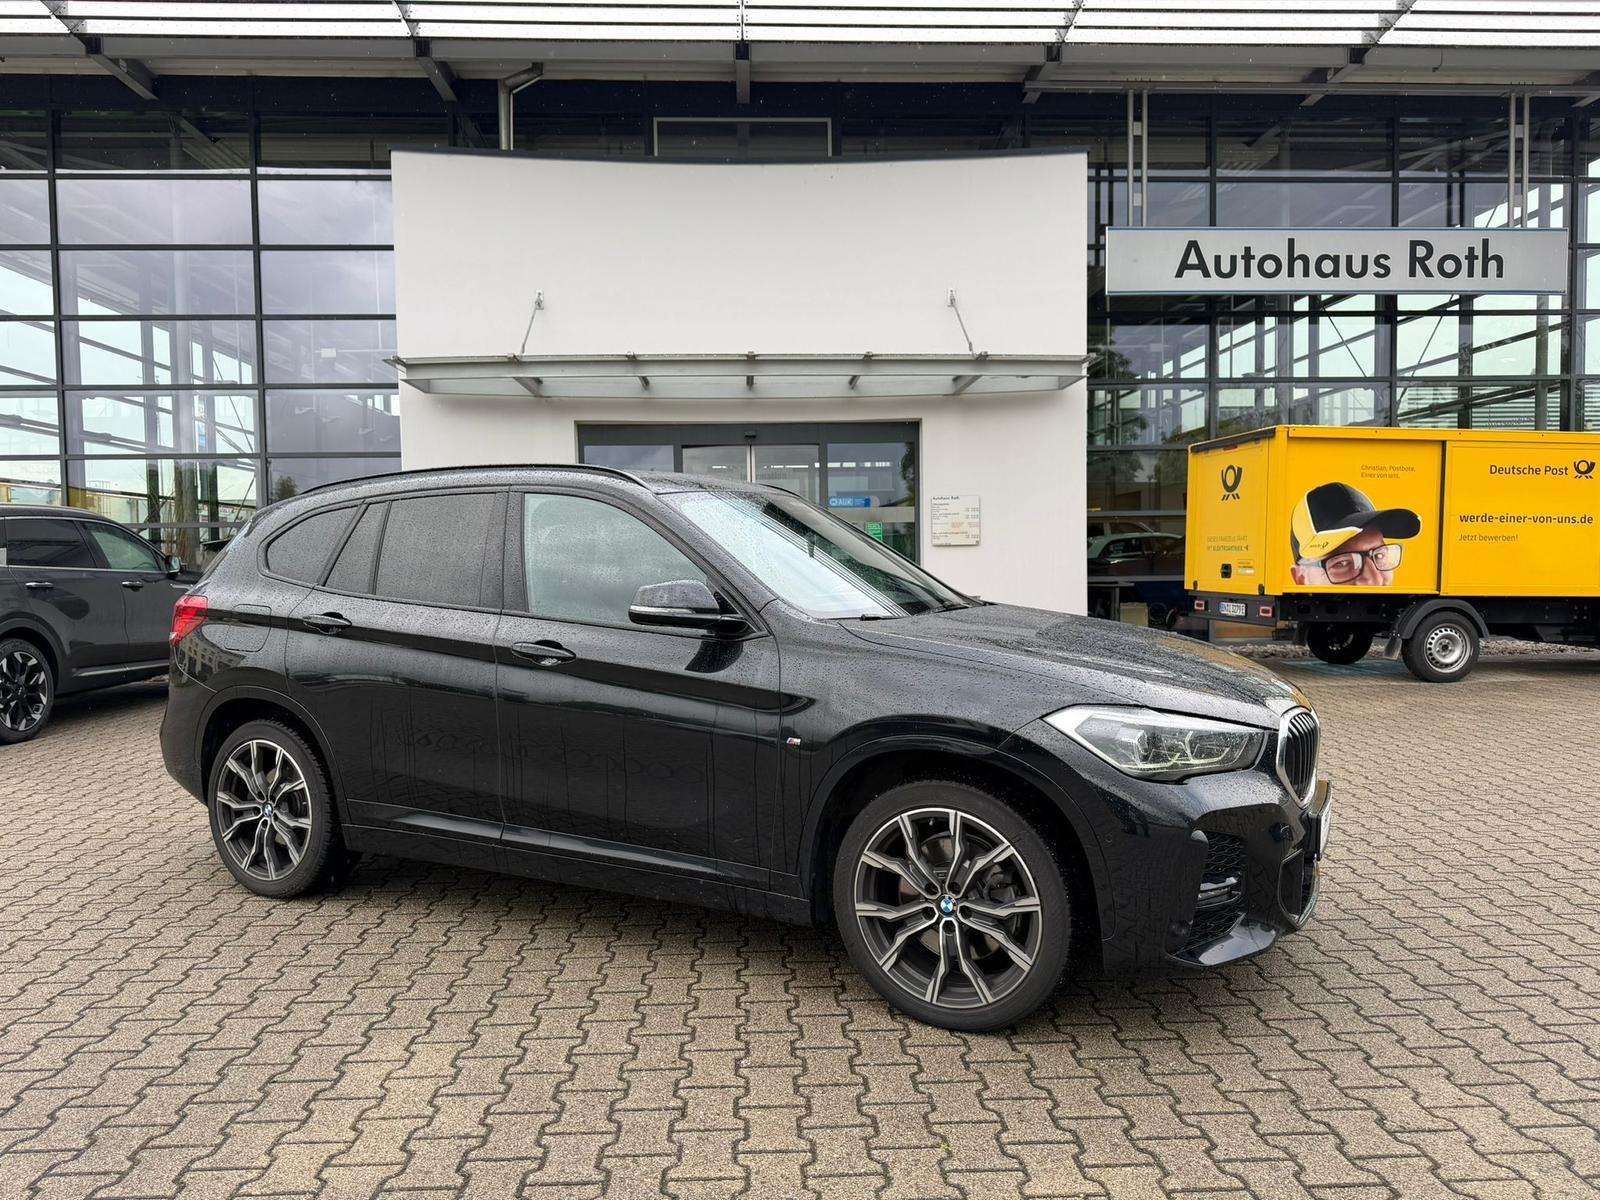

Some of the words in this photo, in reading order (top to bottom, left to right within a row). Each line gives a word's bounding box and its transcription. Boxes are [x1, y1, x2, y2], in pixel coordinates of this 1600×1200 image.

[1174, 238, 1392, 279] Autohaus
[1408, 238, 1505, 279] Roth
[1489, 464, 1541, 475] Deutsche
[1544, 465, 1569, 476] Post
[1459, 513, 1594, 524] werde-einer-von-uns.de
[1459, 534, 1478, 542] Jetzt
[1479, 534, 1519, 542] bewerben!
